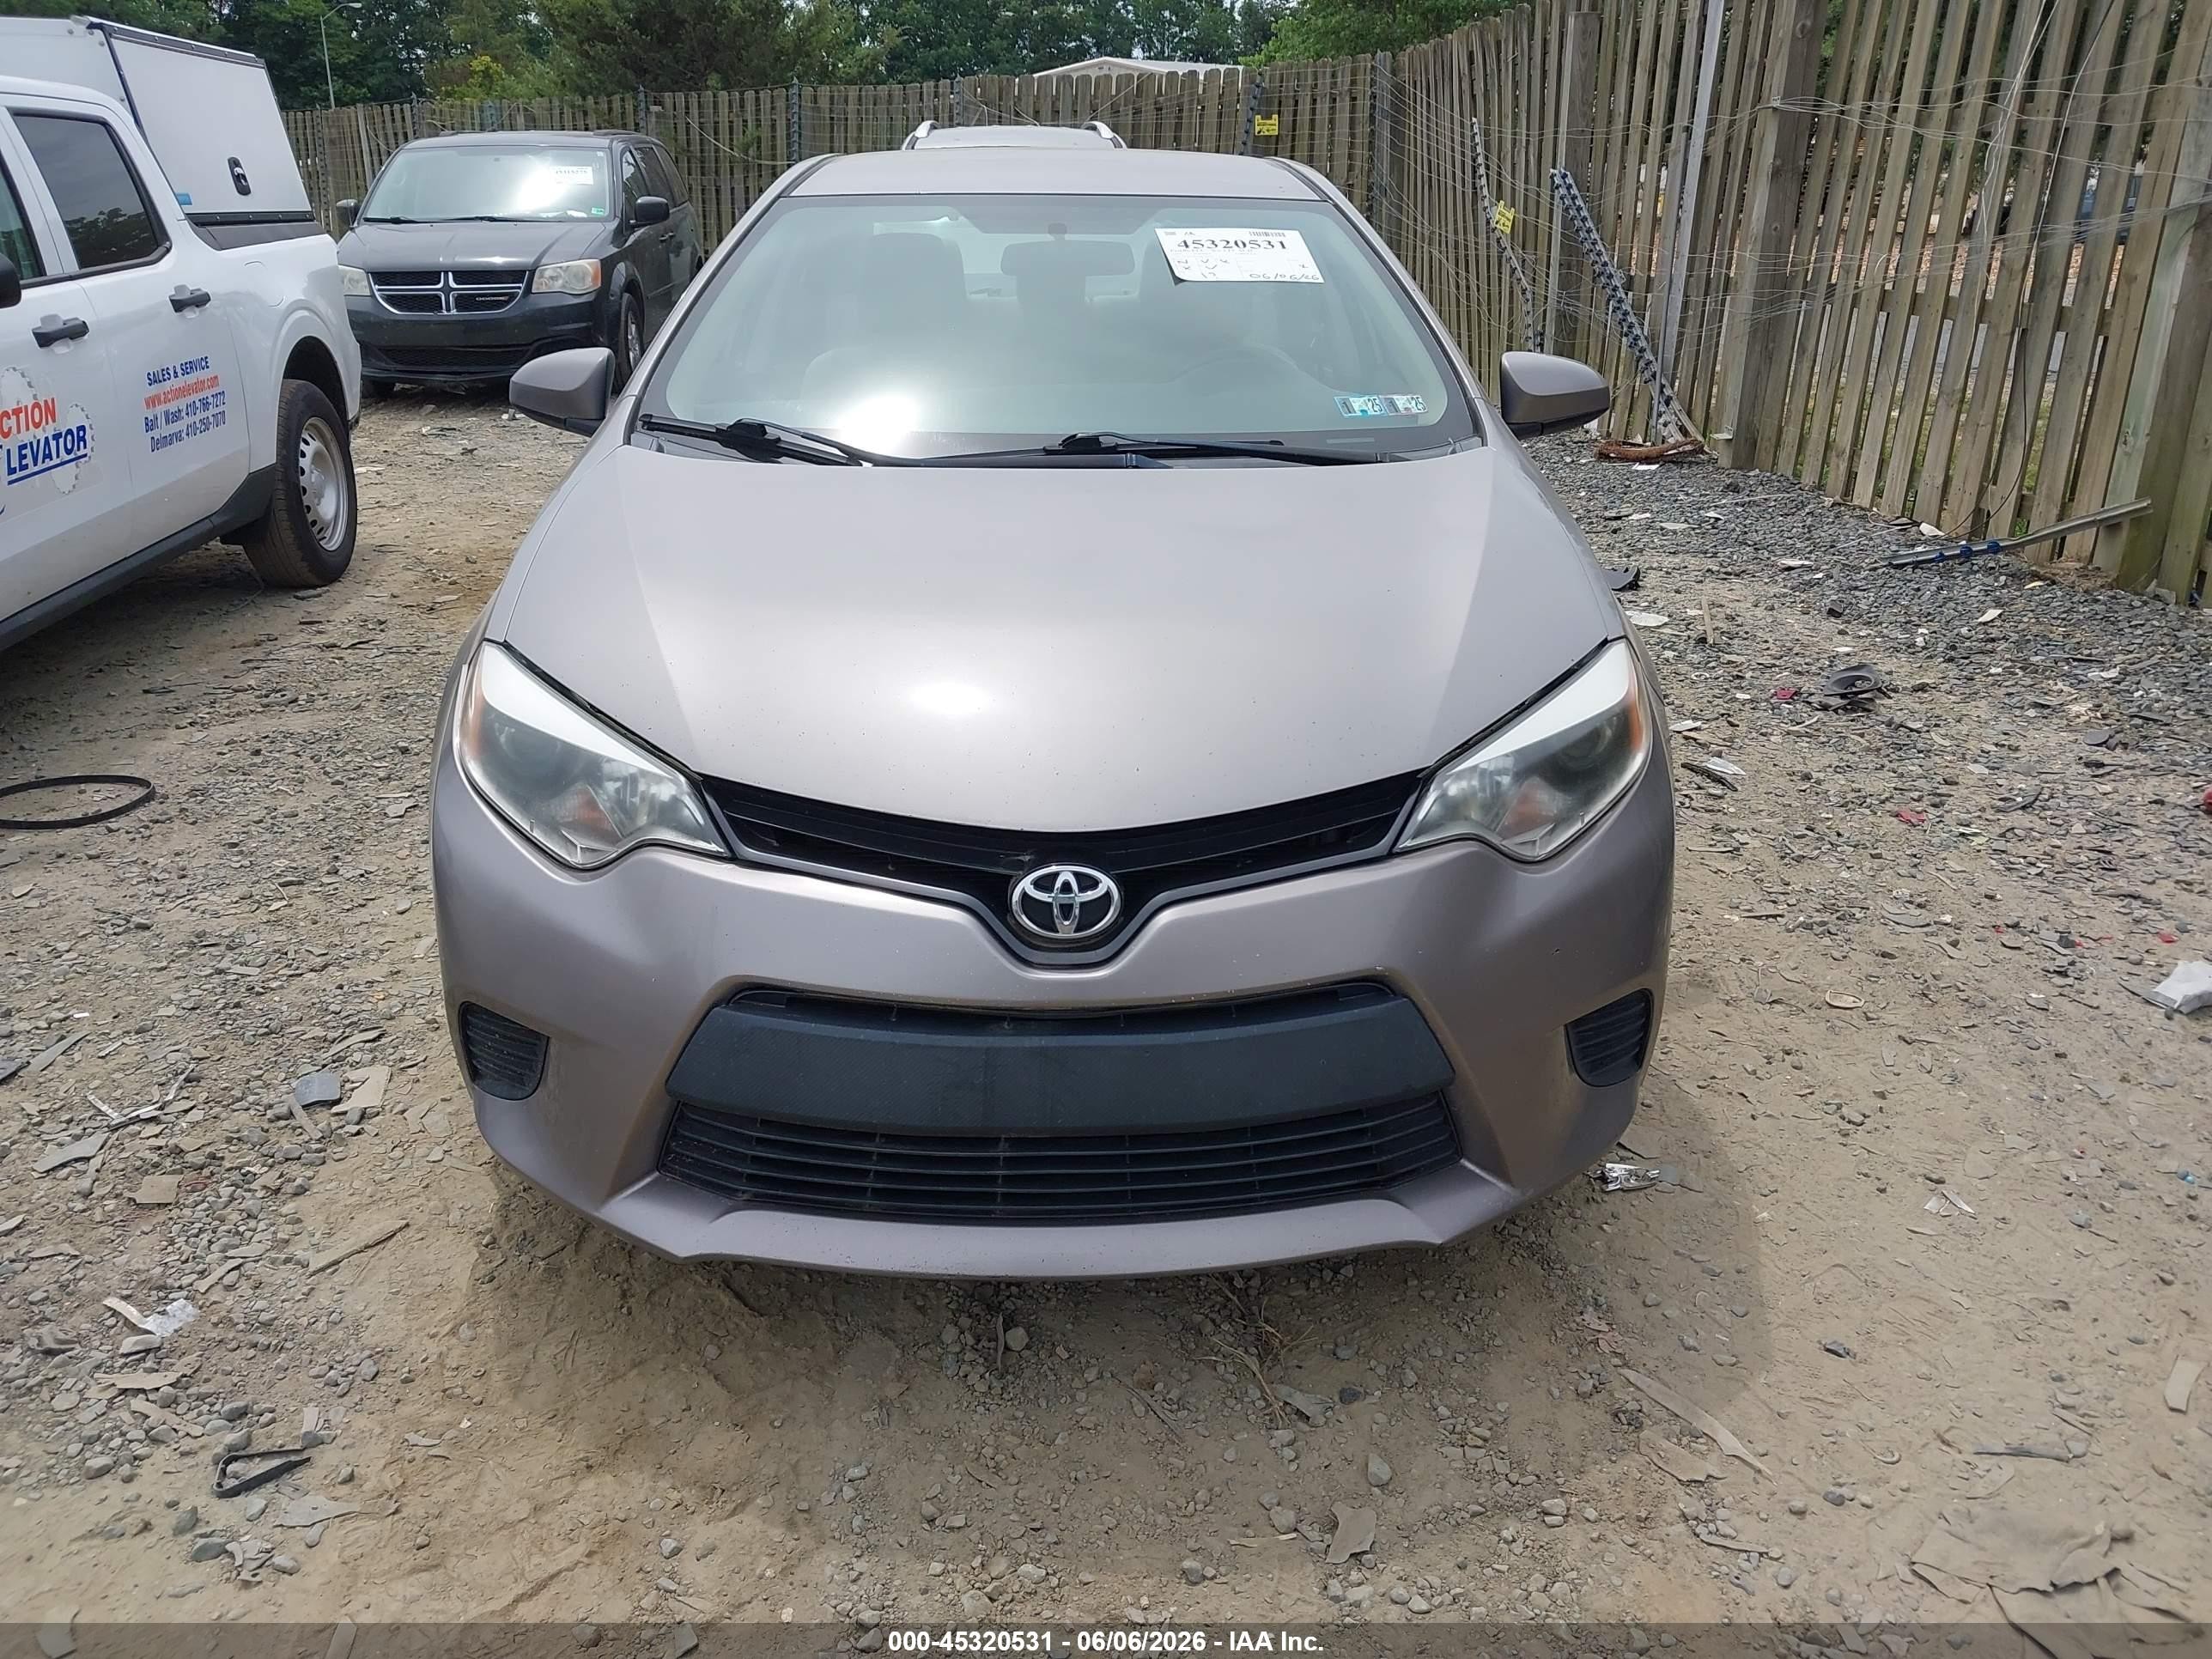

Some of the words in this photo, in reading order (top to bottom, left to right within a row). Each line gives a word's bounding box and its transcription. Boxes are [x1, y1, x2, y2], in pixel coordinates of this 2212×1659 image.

[1177, 240, 1286, 250] 45320531
[146, 367, 172, 386] SALES
[173, 365, 179, 379] &
[179, 356, 210, 377] SERVICE
[144, 374, 220, 410] www.actionelevator.com
[144, 413, 160, 433] Balt
[163, 406, 185, 426] Wash:
[185, 390, 226, 417] 410-766-7272
[0, 424, 88, 476] LEVATOR
[150, 428, 185, 453] Delmarva:
[185, 410, 226, 439] 410-250-7070
